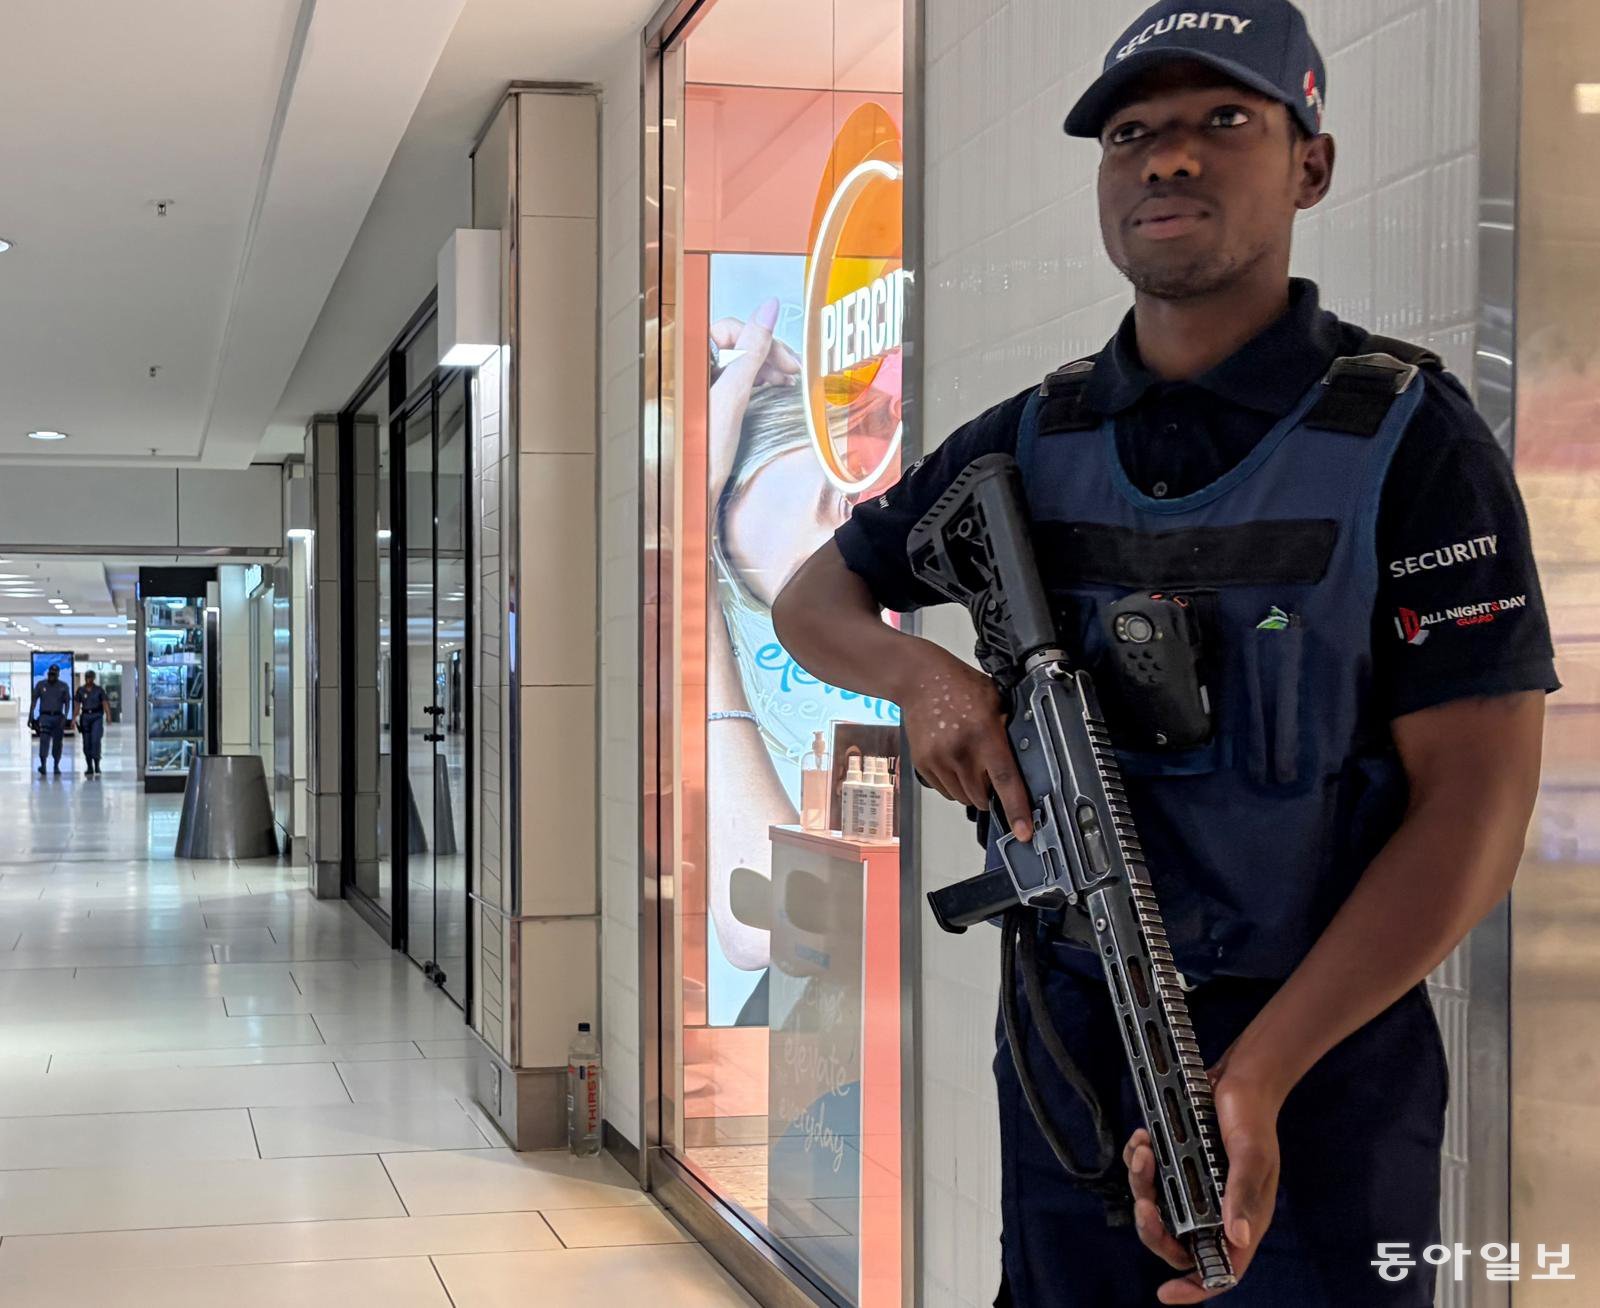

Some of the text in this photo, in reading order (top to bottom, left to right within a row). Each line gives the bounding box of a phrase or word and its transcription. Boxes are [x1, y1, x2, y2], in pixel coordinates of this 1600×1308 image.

[1115, 12, 1252, 60] SECURITY
[1389, 534, 1498, 578] SECURITY
[1420, 611, 1446, 627] ALL
